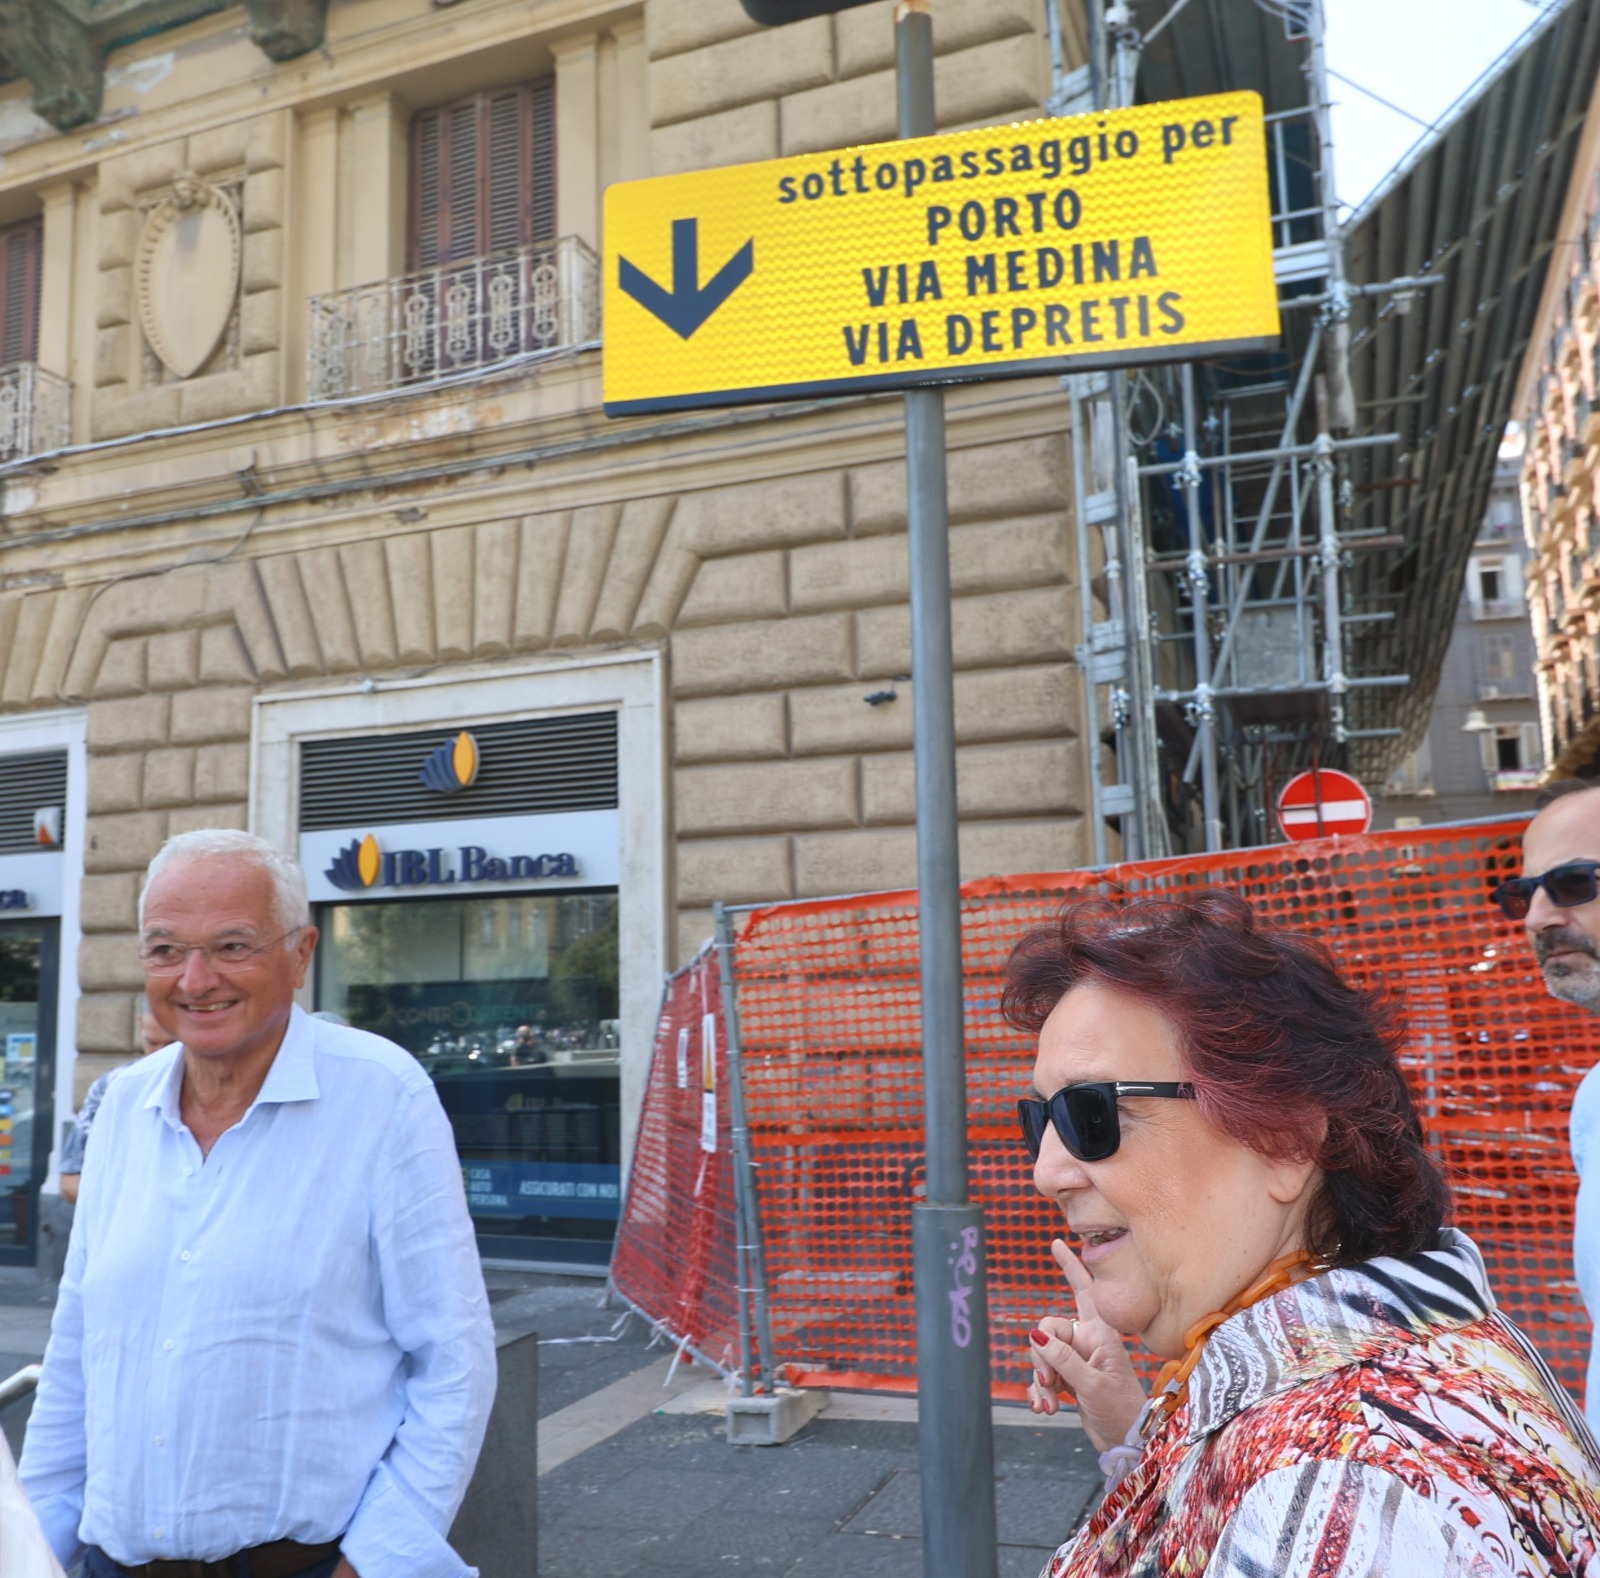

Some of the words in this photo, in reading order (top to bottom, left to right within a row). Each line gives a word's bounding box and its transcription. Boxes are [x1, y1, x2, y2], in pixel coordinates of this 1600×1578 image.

[778, 121, 1139, 204] sottopassaggio
[1162, 115, 1238, 164] per
[926, 188, 1082, 246] PORTO
[862, 260, 943, 307] VIA
[965, 236, 1157, 297] MEDINA
[842, 318, 923, 366] VIA
[946, 291, 1184, 356] DEPRETIS
[382, 847, 454, 887] IBL
[458, 845, 578, 882] Banca
